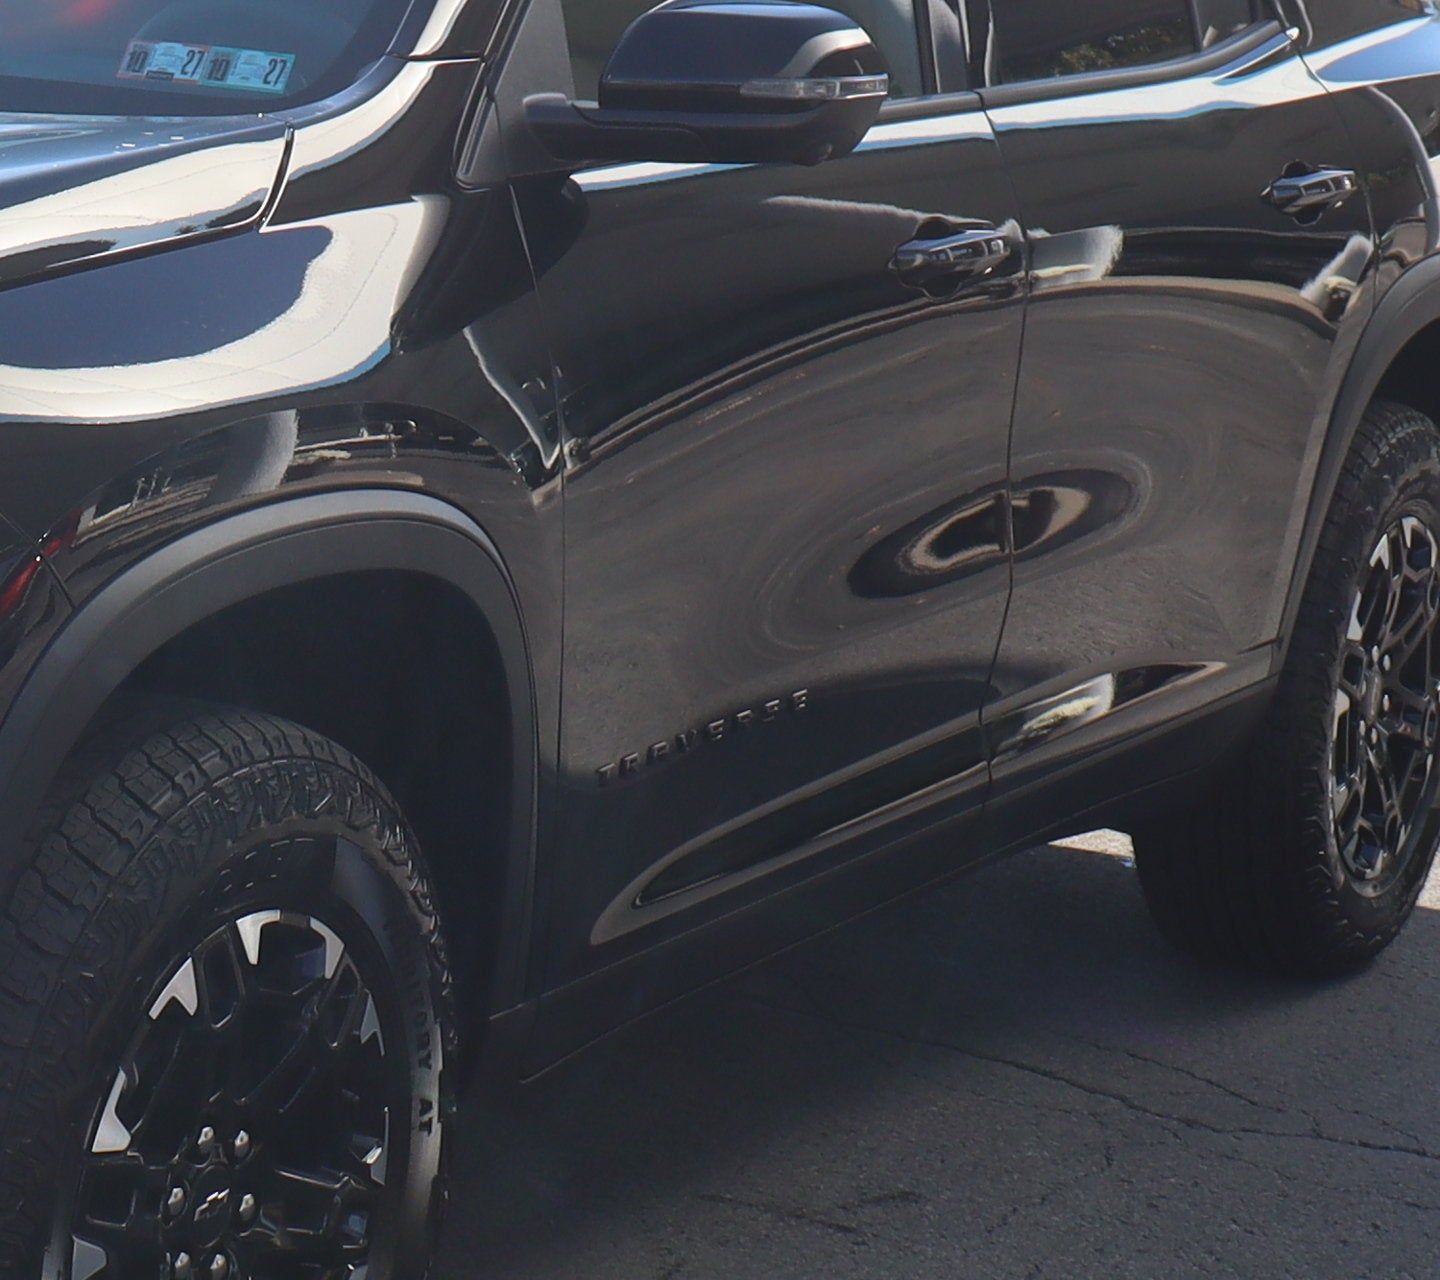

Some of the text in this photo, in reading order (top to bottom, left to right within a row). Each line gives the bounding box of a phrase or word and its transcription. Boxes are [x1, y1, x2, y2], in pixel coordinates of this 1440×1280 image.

[126, 49, 149, 73] 10
[180, 49, 206, 78] 27
[262, 58, 288, 87] 27
